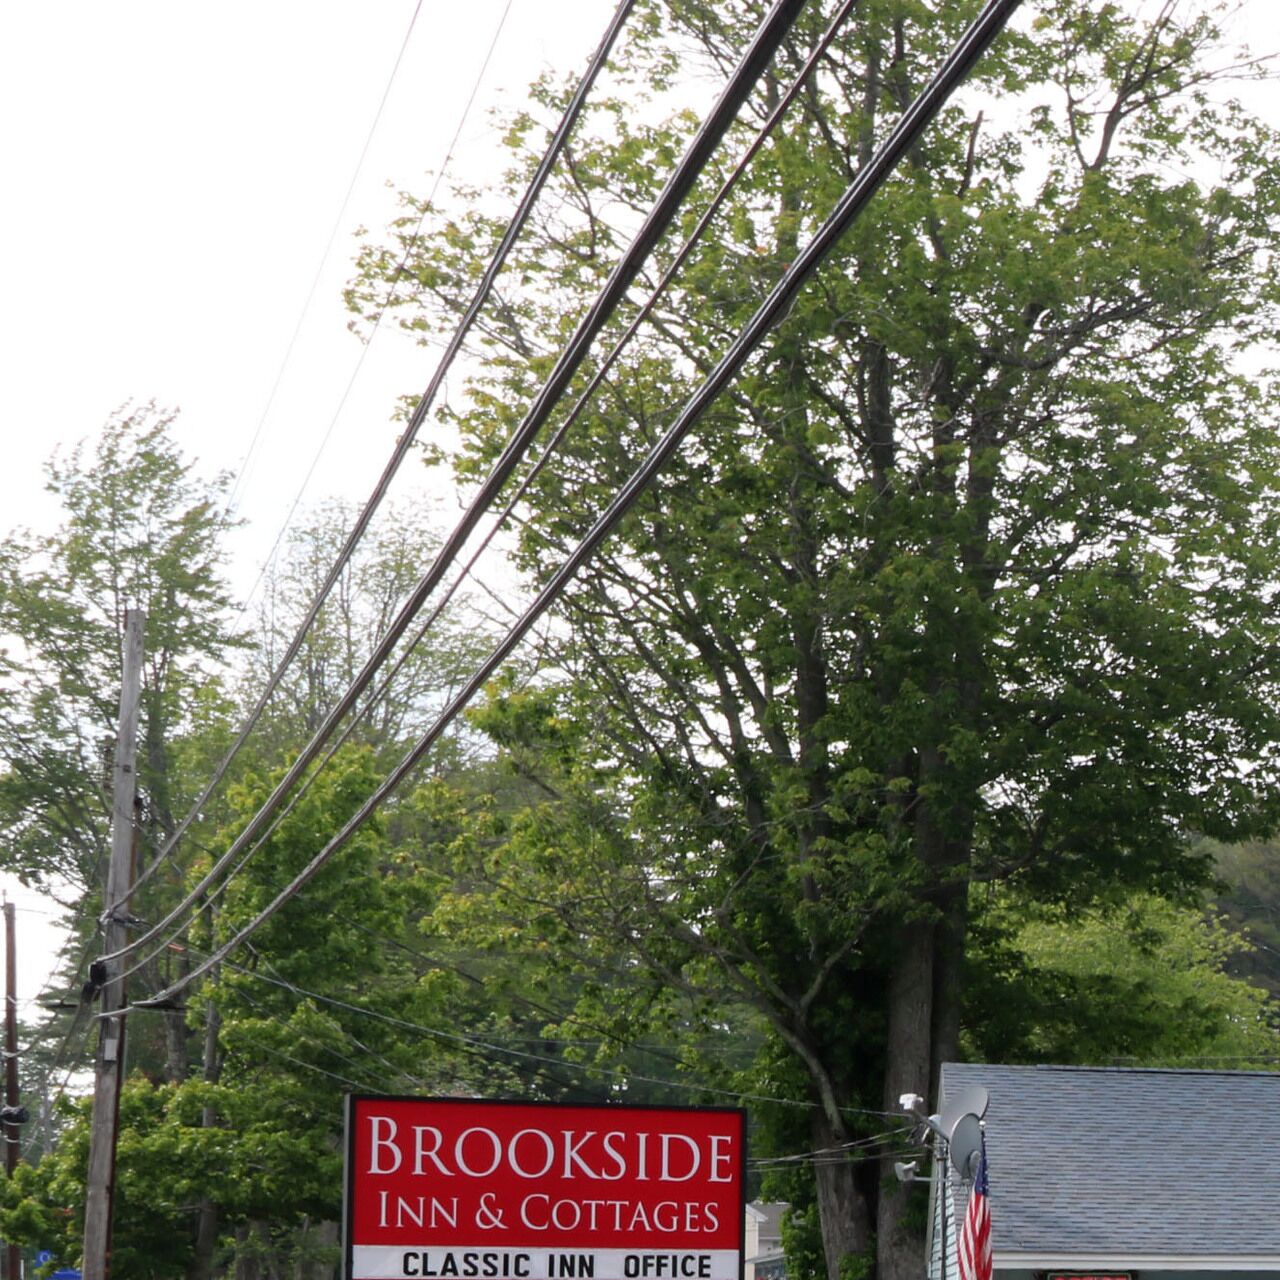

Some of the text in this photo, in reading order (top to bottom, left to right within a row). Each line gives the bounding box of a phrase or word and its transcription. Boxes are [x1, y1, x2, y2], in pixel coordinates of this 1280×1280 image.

[366, 1115, 733, 1183] BROOKSIDE
[378, 1190, 720, 1233] INN & COTTAGES
[402, 1251, 712, 1279] CLASSIC INN OFFICE
